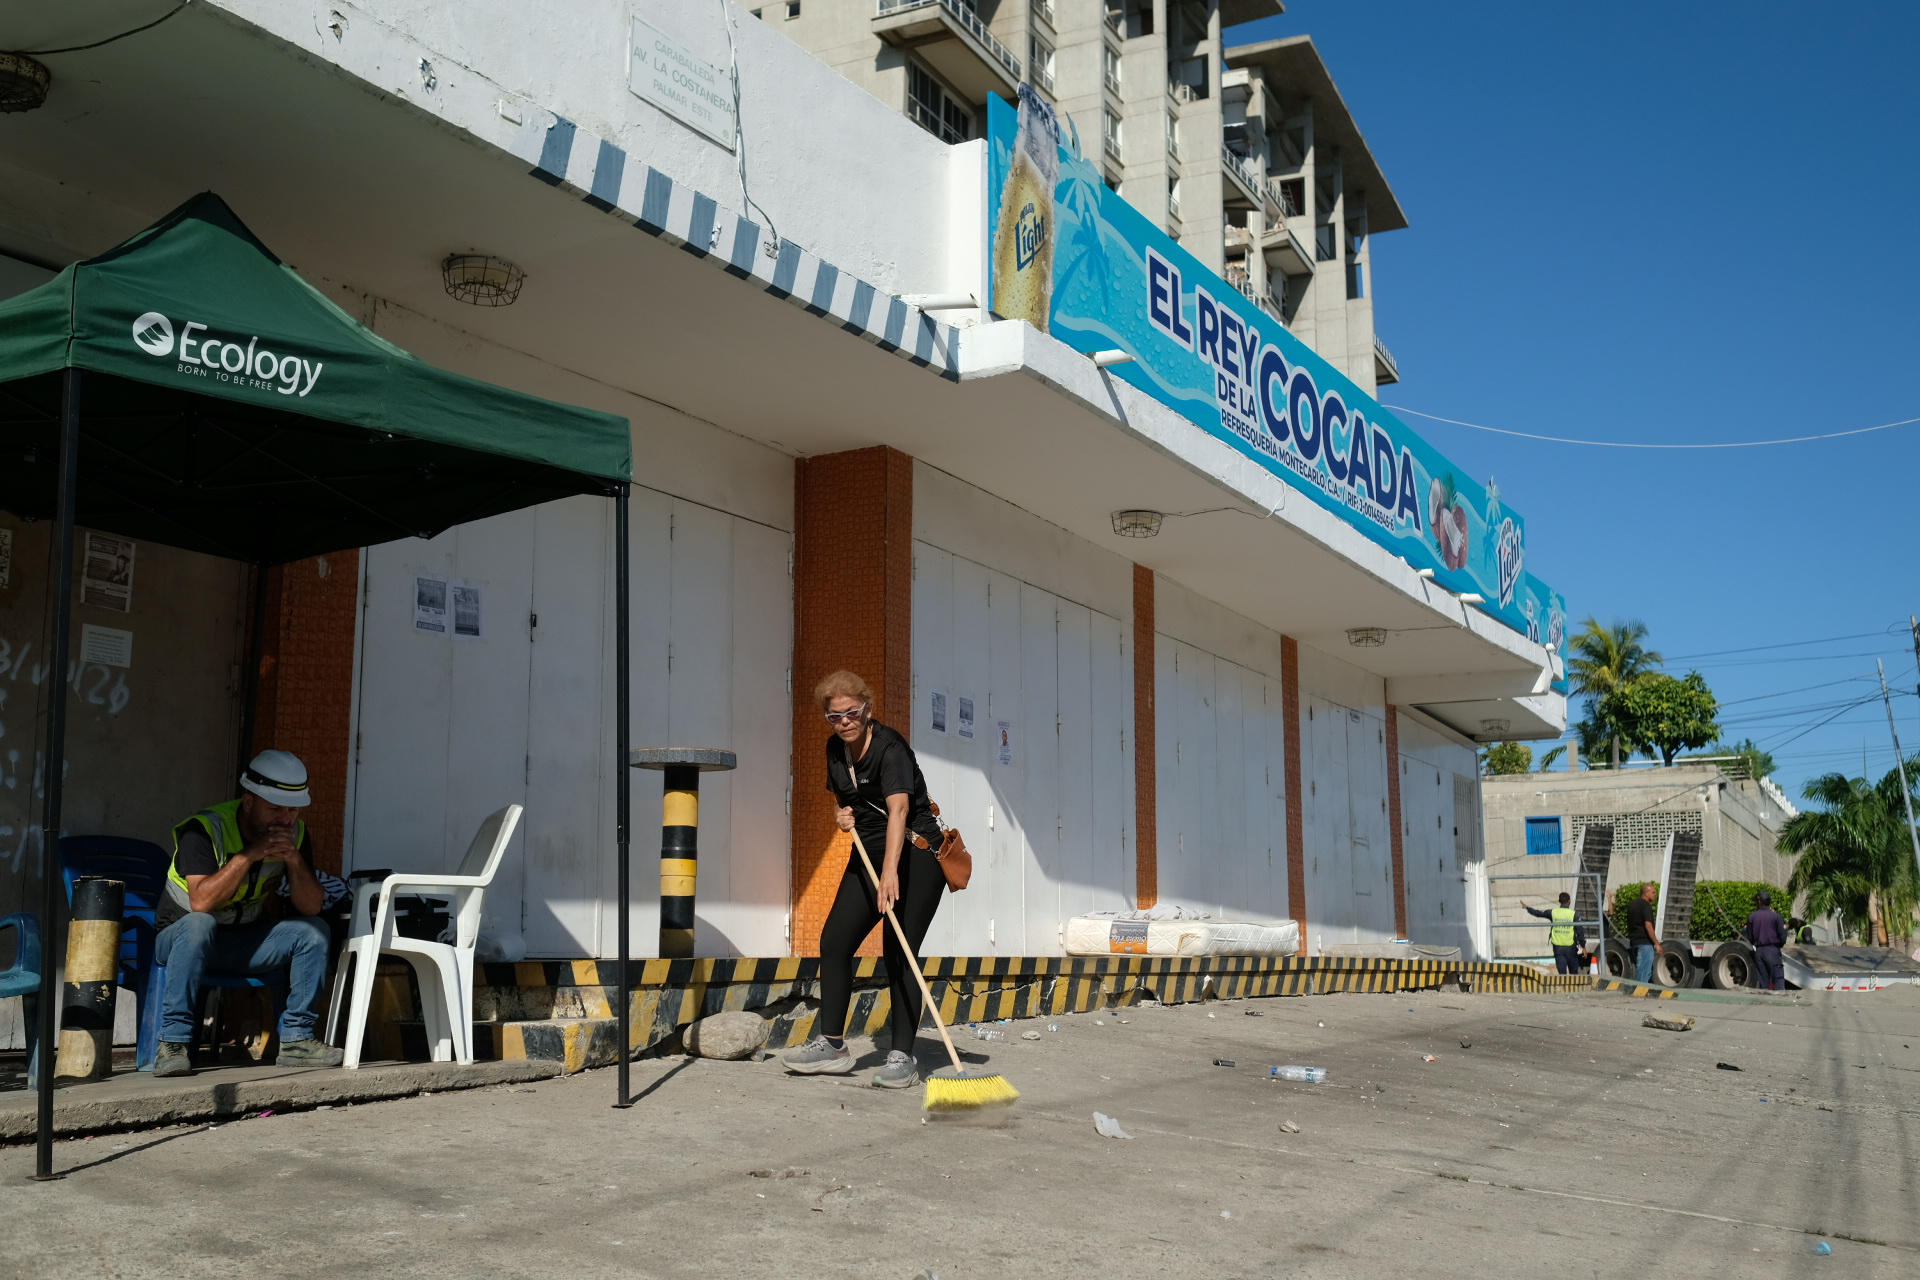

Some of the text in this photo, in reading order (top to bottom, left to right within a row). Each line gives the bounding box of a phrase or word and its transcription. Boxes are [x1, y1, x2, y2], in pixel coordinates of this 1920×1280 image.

[633, 46, 733, 116] AV. LA COSTANERA
[653, 79, 687, 107] PALMAR
[1015, 215, 1046, 272] Light
[1149, 254, 1258, 388] EL REY
[177, 363, 273, 391] BORN TO BE FREE
[179, 321, 323, 397] Ecology
[1217, 372, 1257, 424] DE LA
[1221, 409, 1278, 460] REFRESQUERÍA
[1259, 350, 1421, 531] COCADA
[1498, 535, 1521, 604] Light
